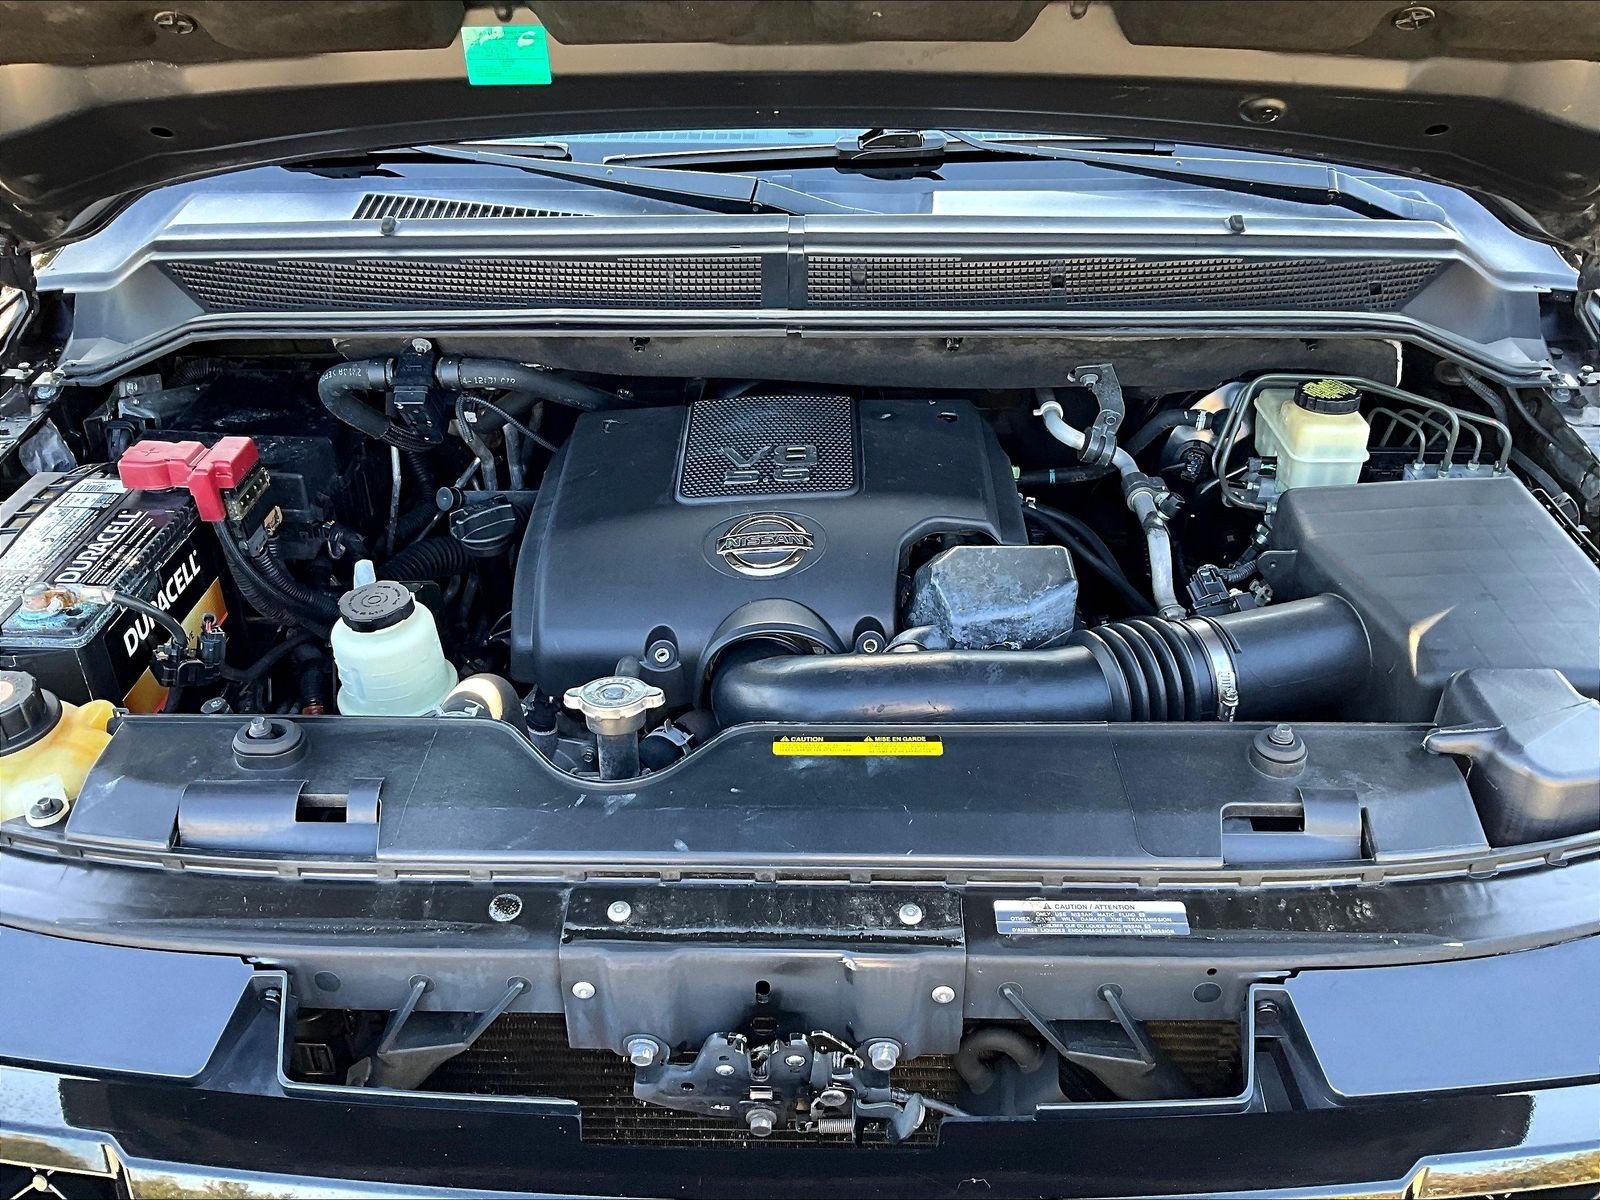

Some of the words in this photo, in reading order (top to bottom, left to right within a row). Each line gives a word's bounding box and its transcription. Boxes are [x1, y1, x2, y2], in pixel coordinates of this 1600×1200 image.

[719, 444, 818, 467] V8
[54, 510, 143, 583] DURACELL
[726, 534, 804, 548] NISSAN
